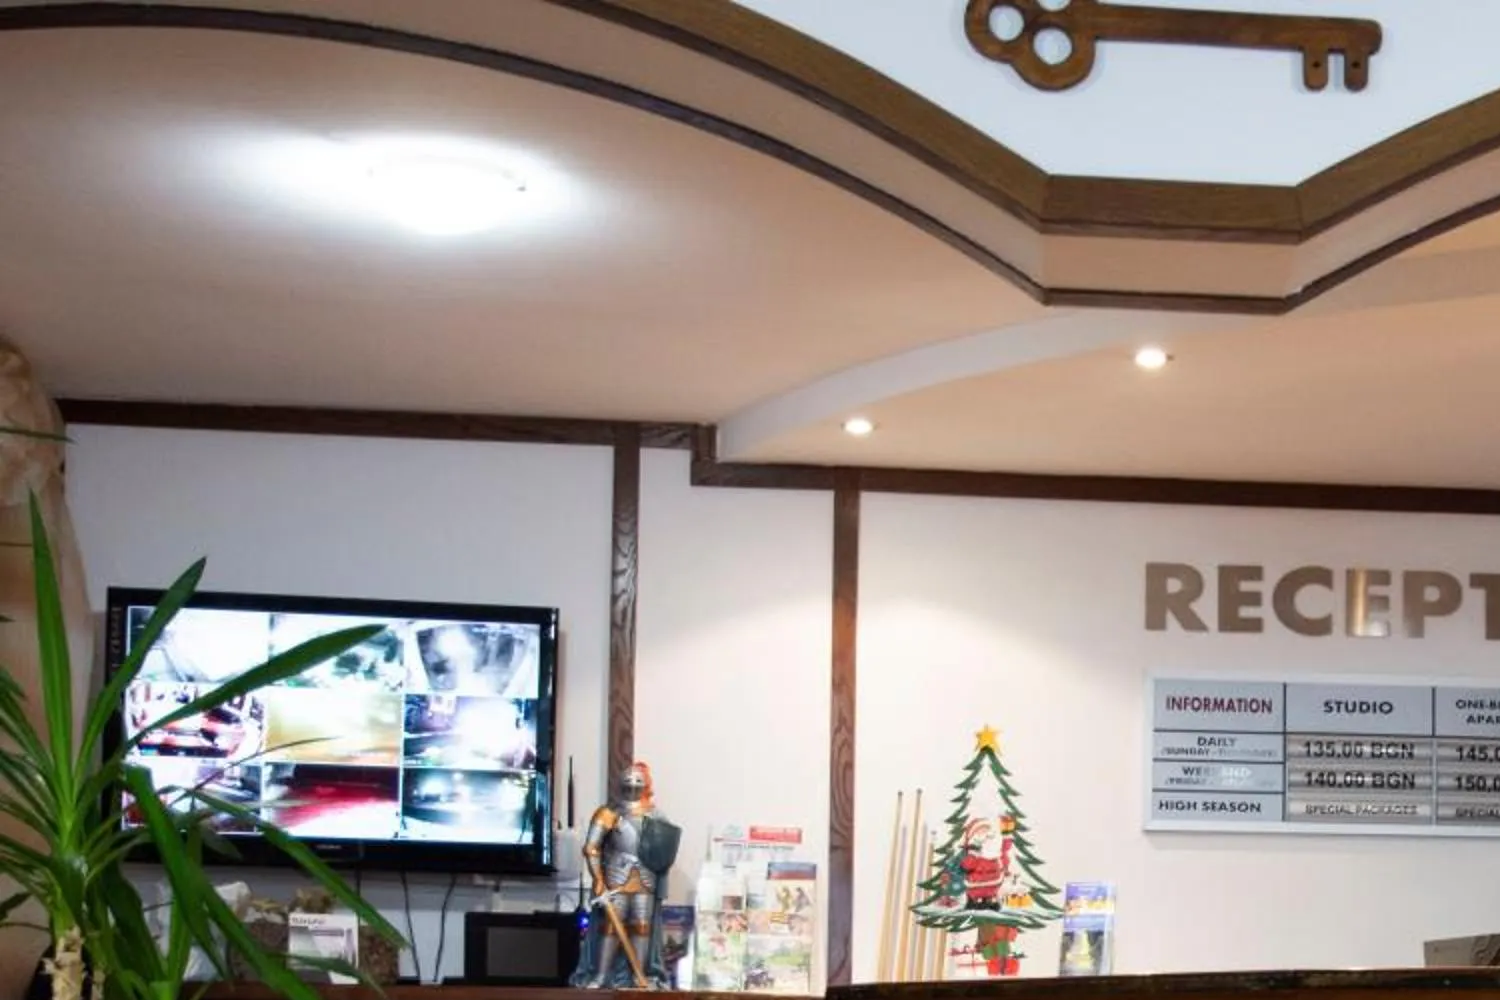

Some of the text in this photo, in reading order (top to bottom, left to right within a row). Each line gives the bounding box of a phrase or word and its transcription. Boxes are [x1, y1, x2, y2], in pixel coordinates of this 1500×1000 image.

[1165, 697, 1273, 713] INFORMATION
[1323, 700, 1394, 715] STUDIO
[1197, 736, 1238, 747] DAILY
[1304, 741, 1415, 759] 135.00 BGN
[1304, 772, 1416, 789] 140.00 BGN
[1158, 800, 1262, 813] HIGH SEASON
